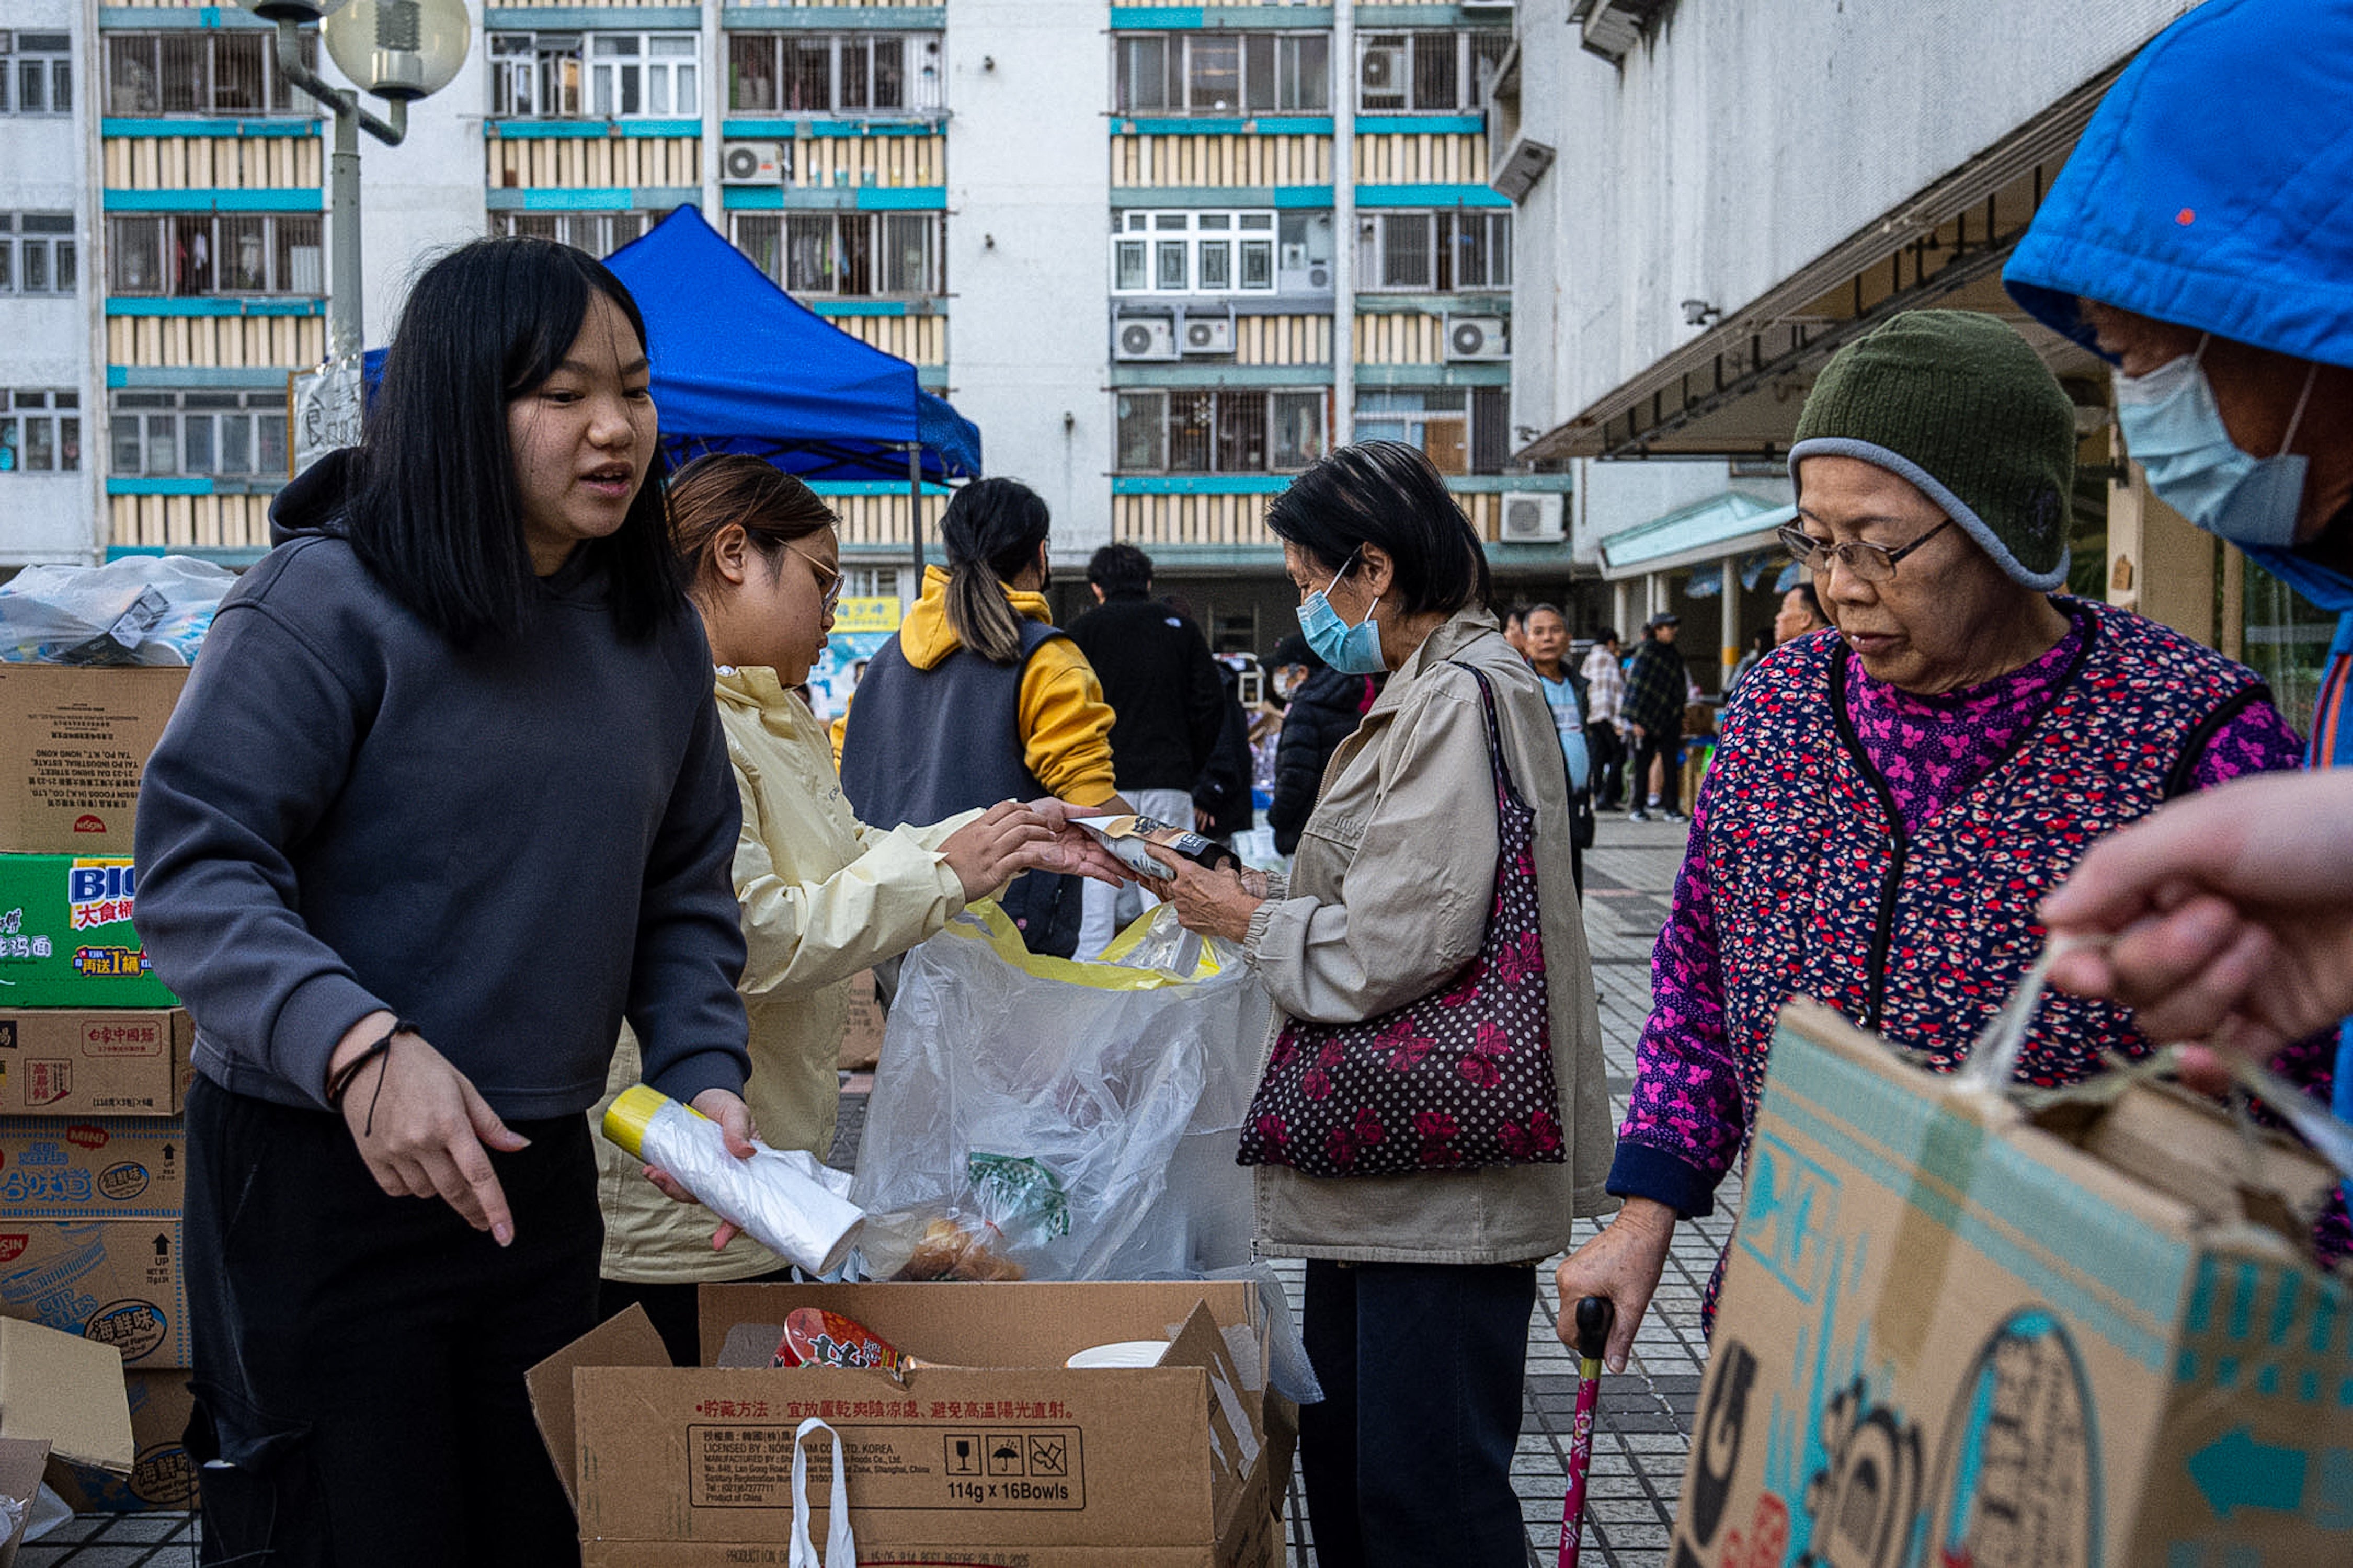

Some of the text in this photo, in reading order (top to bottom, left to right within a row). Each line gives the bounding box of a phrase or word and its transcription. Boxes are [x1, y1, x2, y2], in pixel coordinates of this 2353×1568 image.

[70, 1129, 105, 1144] MINI
[155, 1257, 169, 1266] UP
[704, 1443, 747, 1453] LICENSED
[749, 1443, 761, 1453] BY
[863, 1444, 894, 1454] KOREA
[706, 1494, 733, 1502] Product
[947, 1482, 984, 1503] 114g
[1001, 1482, 1069, 1500] 16Bowls
[726, 1549, 776, 1563] PRODUCTION
